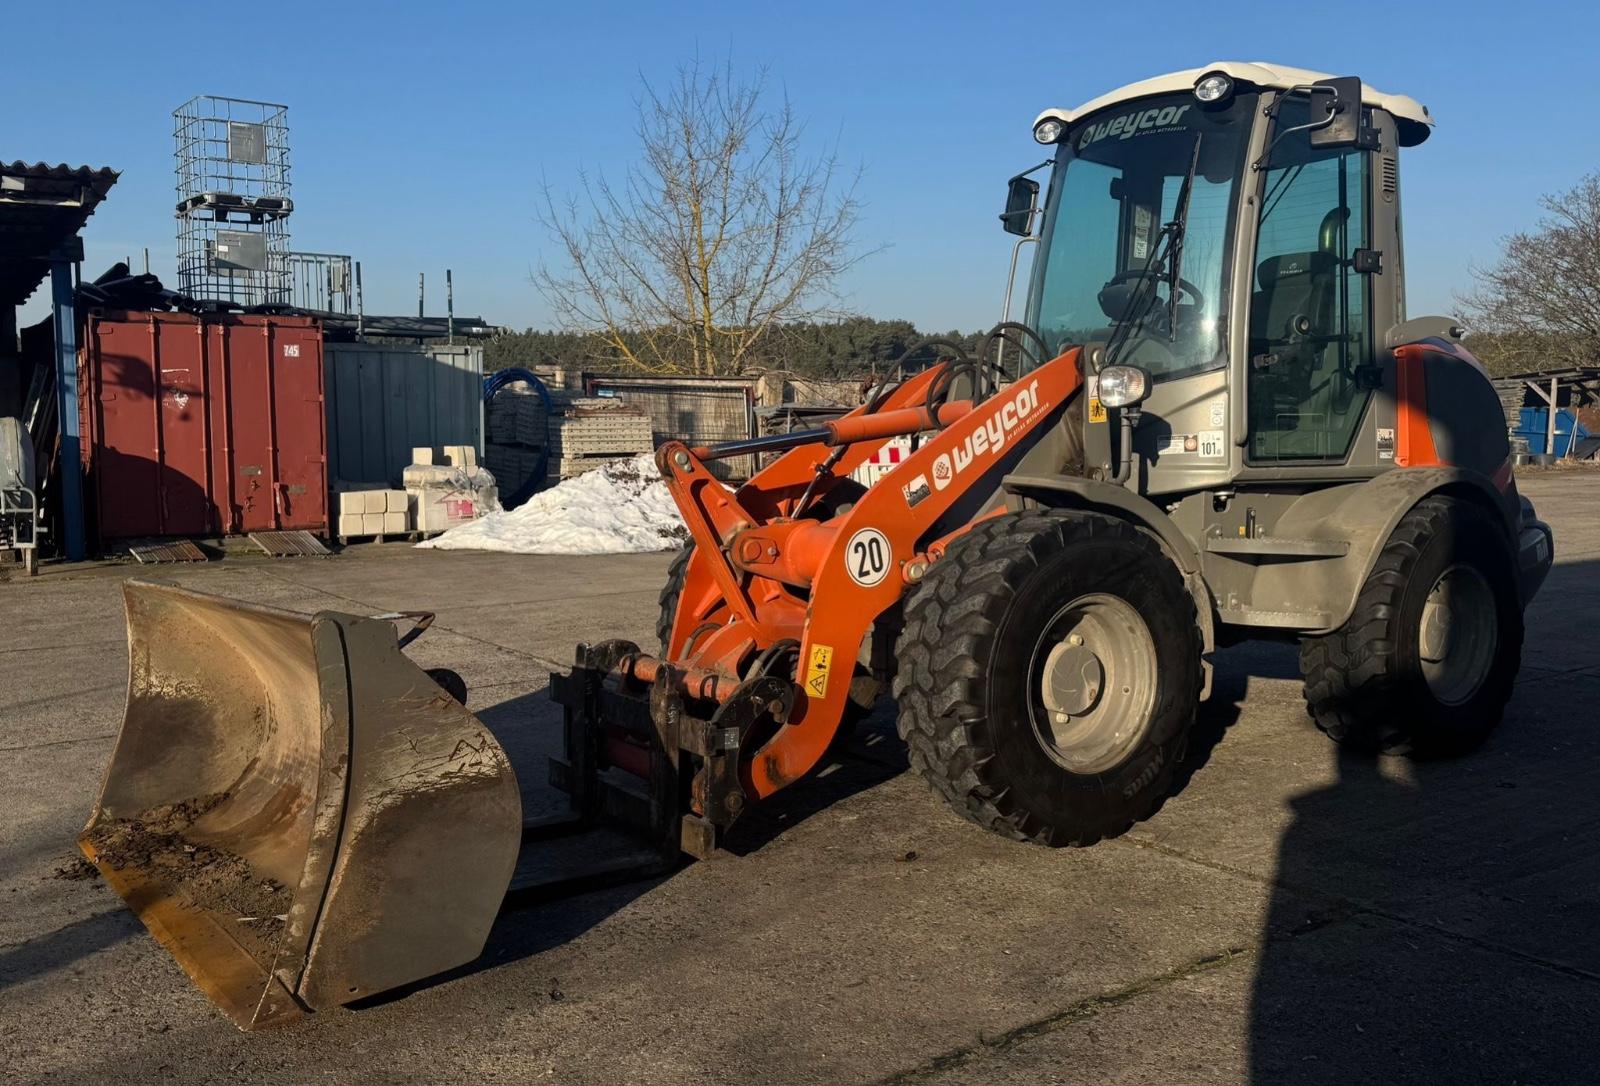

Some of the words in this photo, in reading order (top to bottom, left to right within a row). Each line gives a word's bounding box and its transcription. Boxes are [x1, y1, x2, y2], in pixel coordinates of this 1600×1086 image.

[1092, 105, 1191, 143] weycor
[284, 344, 300, 357] 745
[952, 379, 1039, 475] weycor
[1201, 442, 1216, 456] 101
[853, 537, 884, 578] 20
